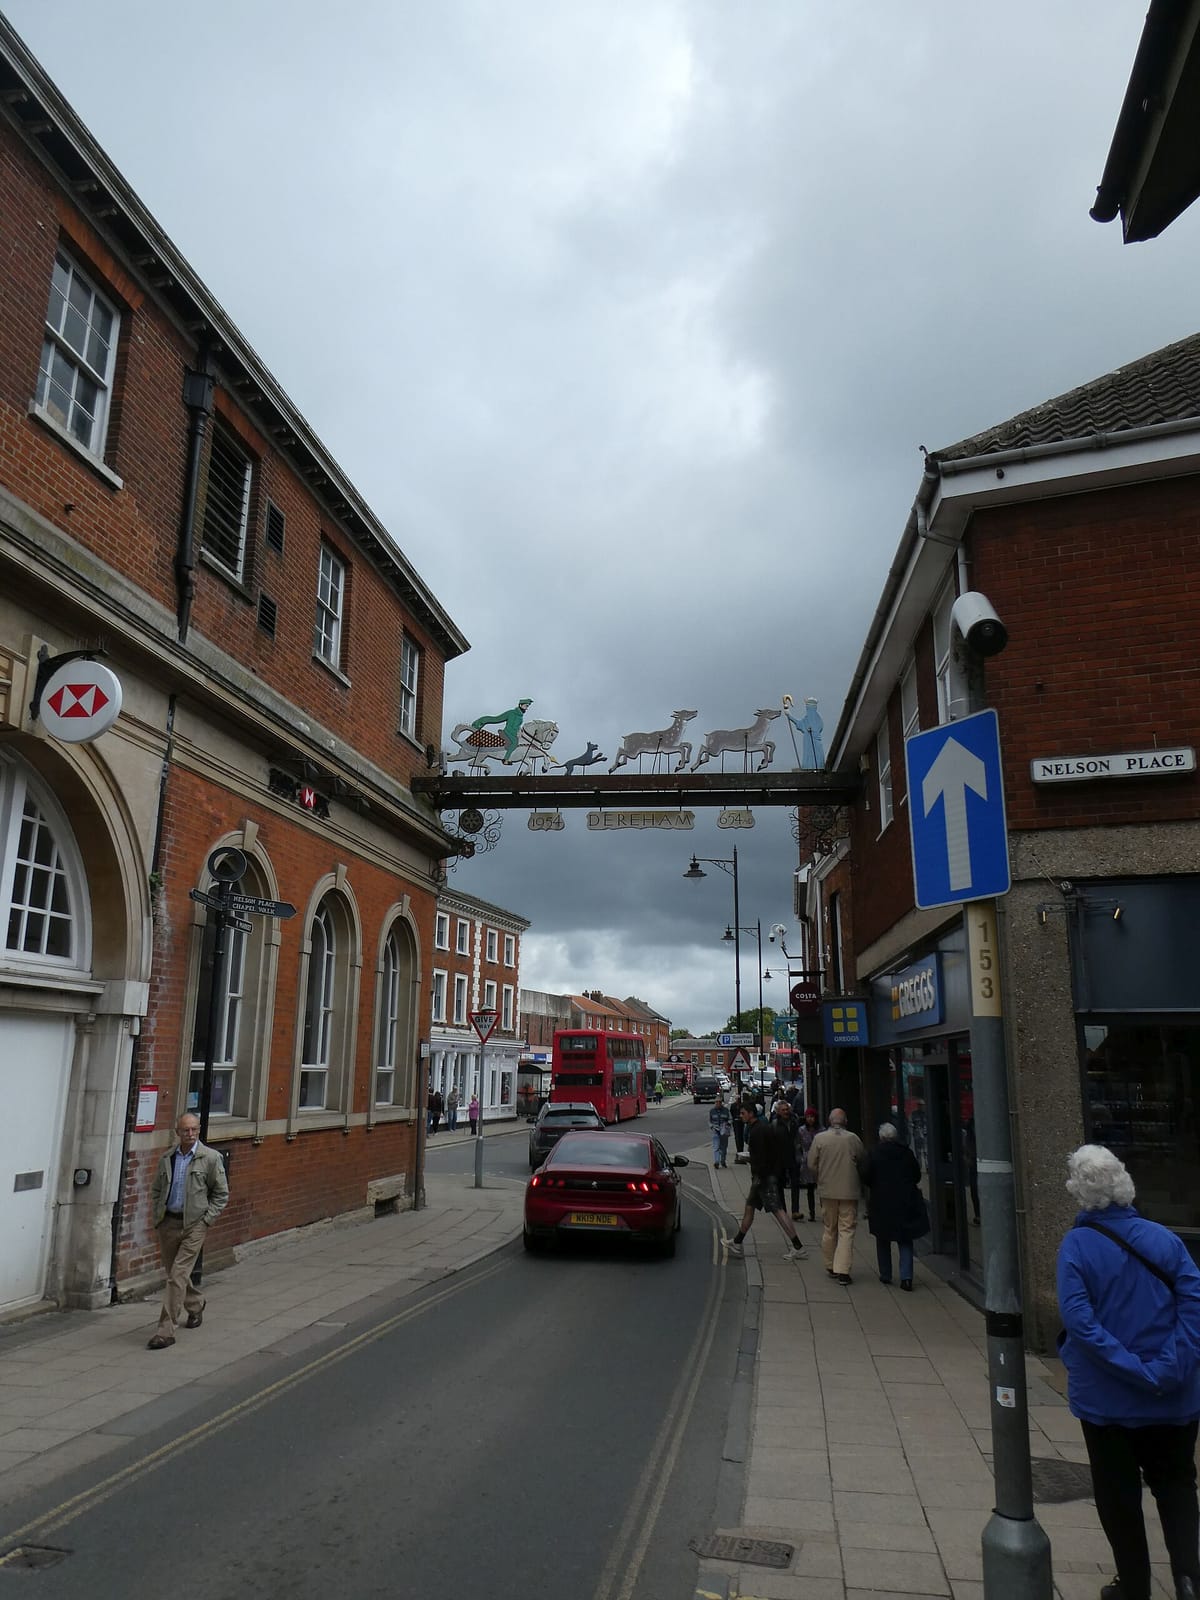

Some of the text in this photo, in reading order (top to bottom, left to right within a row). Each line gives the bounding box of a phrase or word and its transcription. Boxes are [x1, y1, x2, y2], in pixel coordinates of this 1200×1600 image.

[1042, 754, 1185, 776] NELSON PLACE
[532, 814, 561, 828] 1954
[589, 813, 691, 827] DEREHAM
[233, 895, 256, 904] NELSON
[232, 903, 255, 911] CHAPEL
[899, 968, 935, 1017] GREGGS
